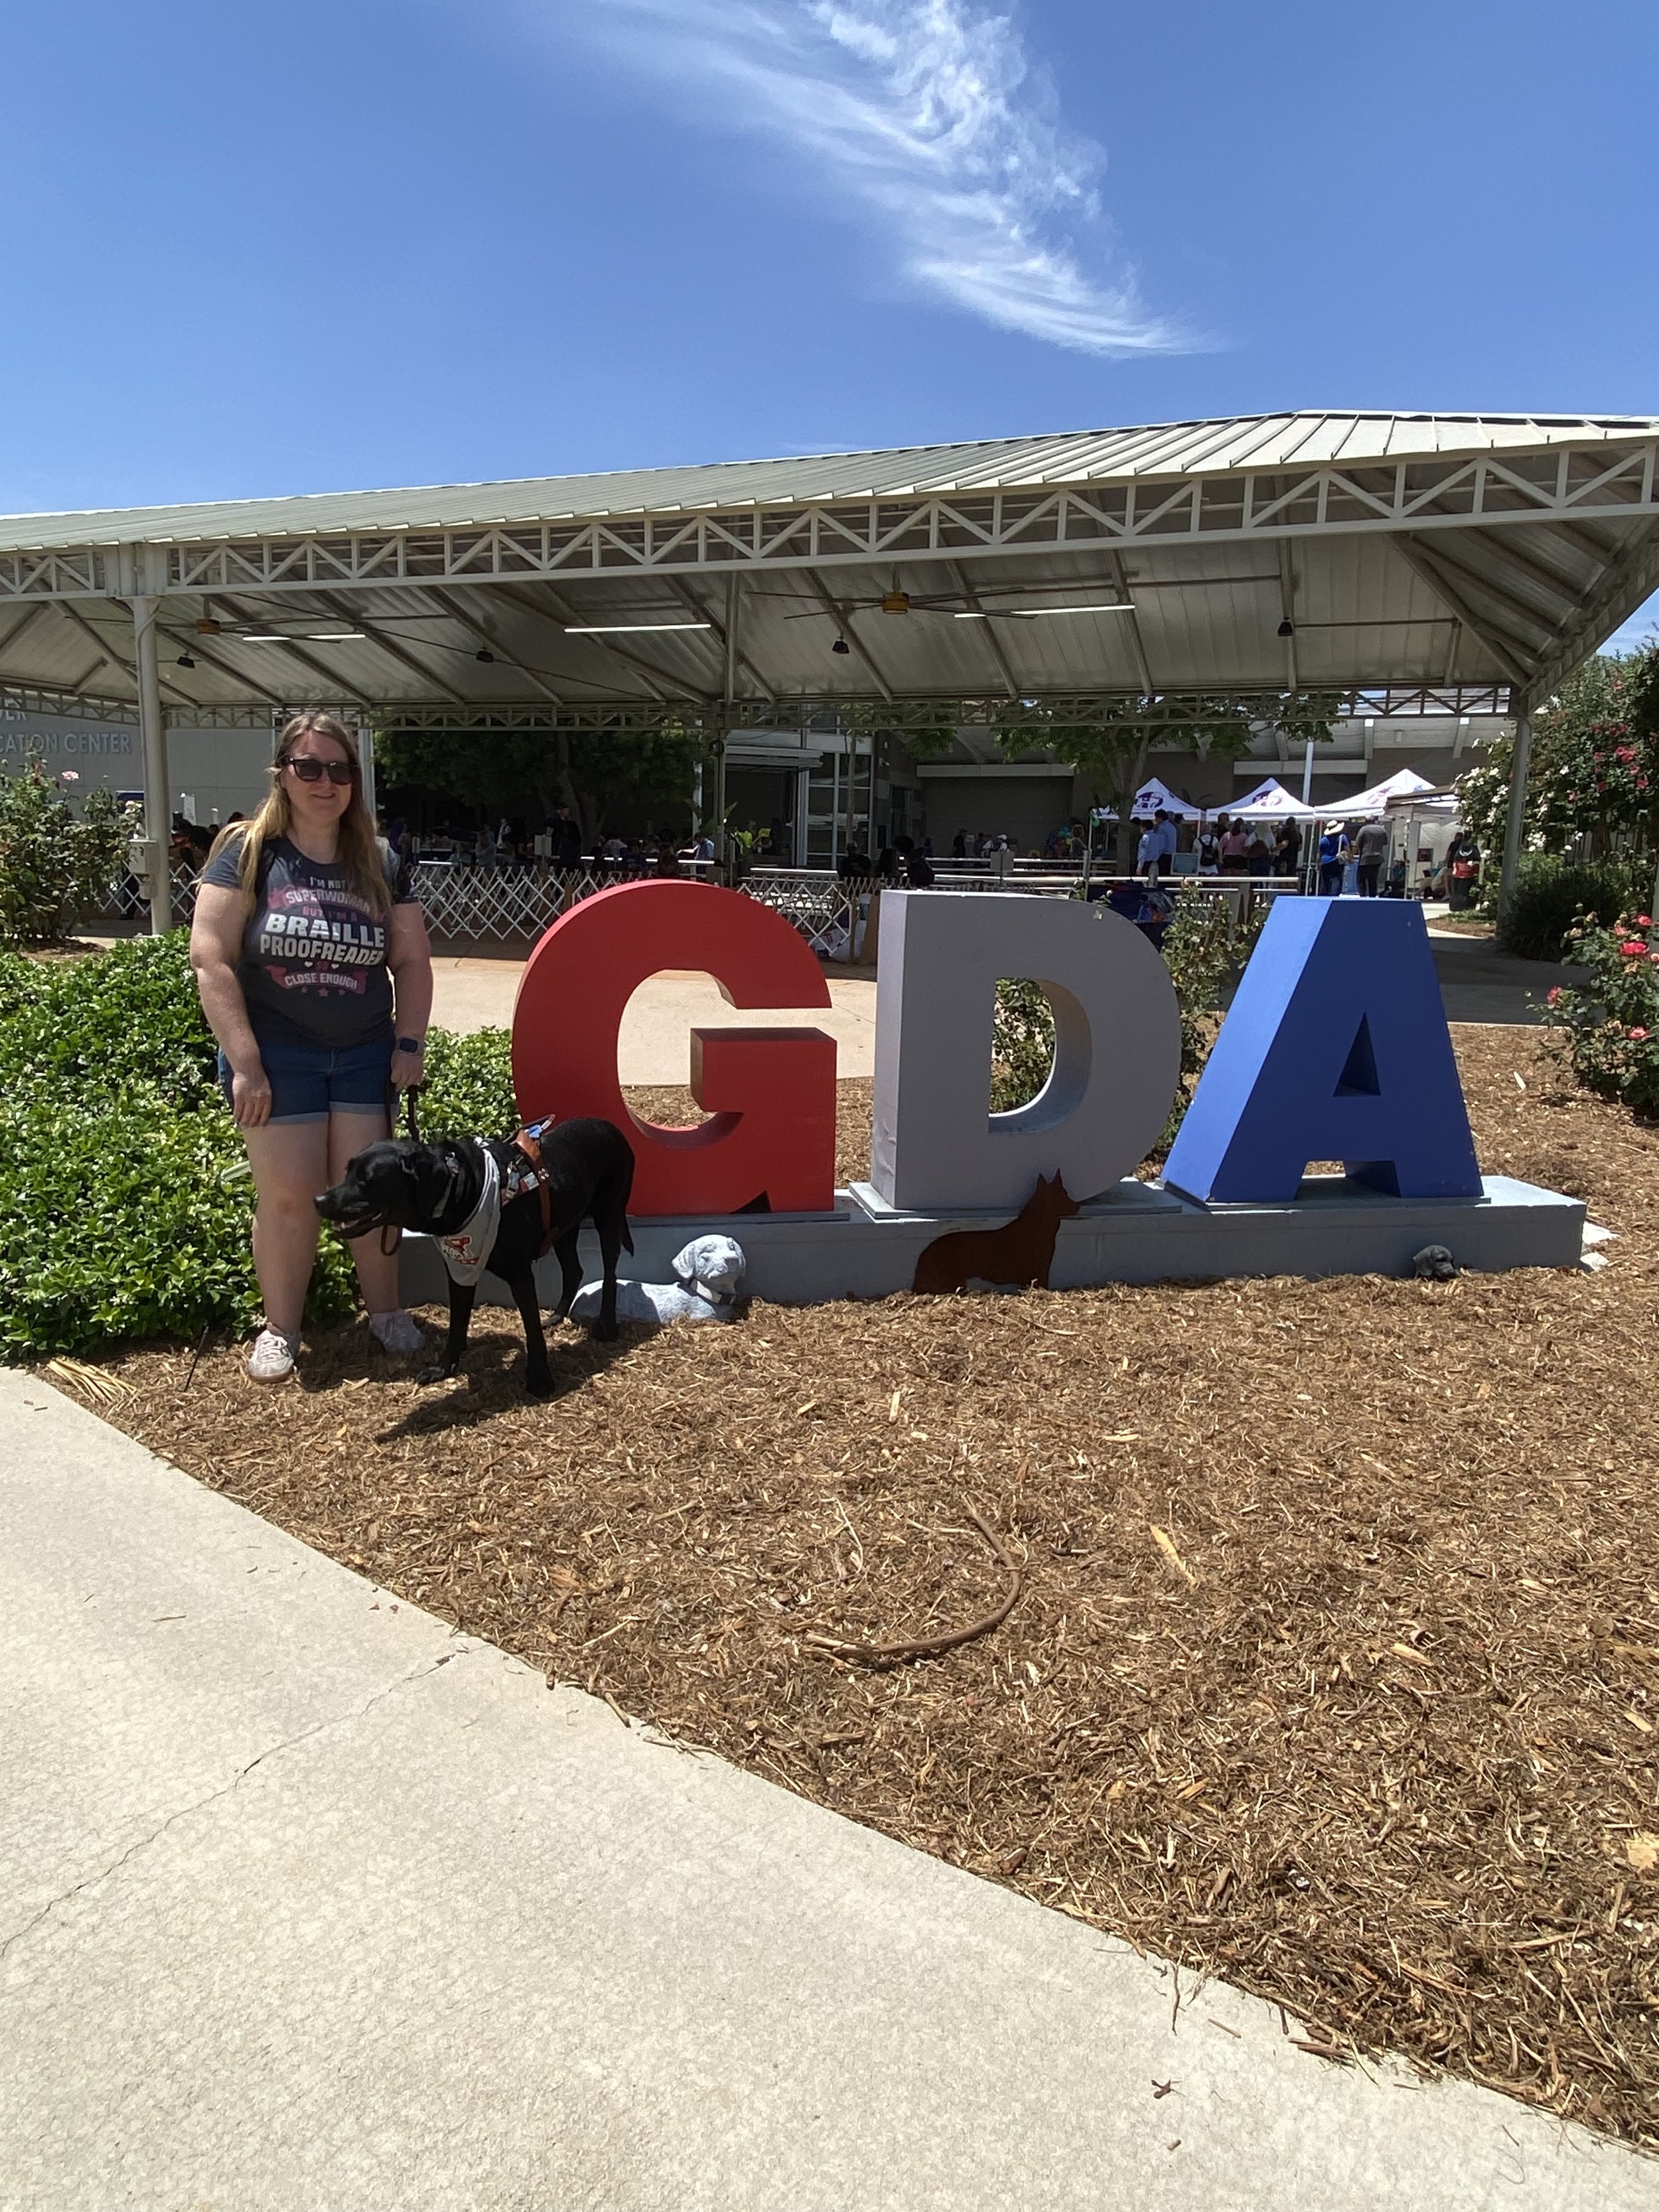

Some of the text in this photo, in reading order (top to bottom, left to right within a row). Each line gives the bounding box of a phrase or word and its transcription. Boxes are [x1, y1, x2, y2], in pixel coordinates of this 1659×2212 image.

[0, 697, 27, 721] ER
[64, 733, 131, 754] CENTER
[328, 879, 346, 889] NOT
[303, 907, 324, 918] BUT
[265, 913, 384, 948] BRAILLE
[260, 934, 384, 966] PROOFREADER
[284, 973, 358, 990] CLOSE ENOUGH
[512, 879, 1484, 1216] GDA
